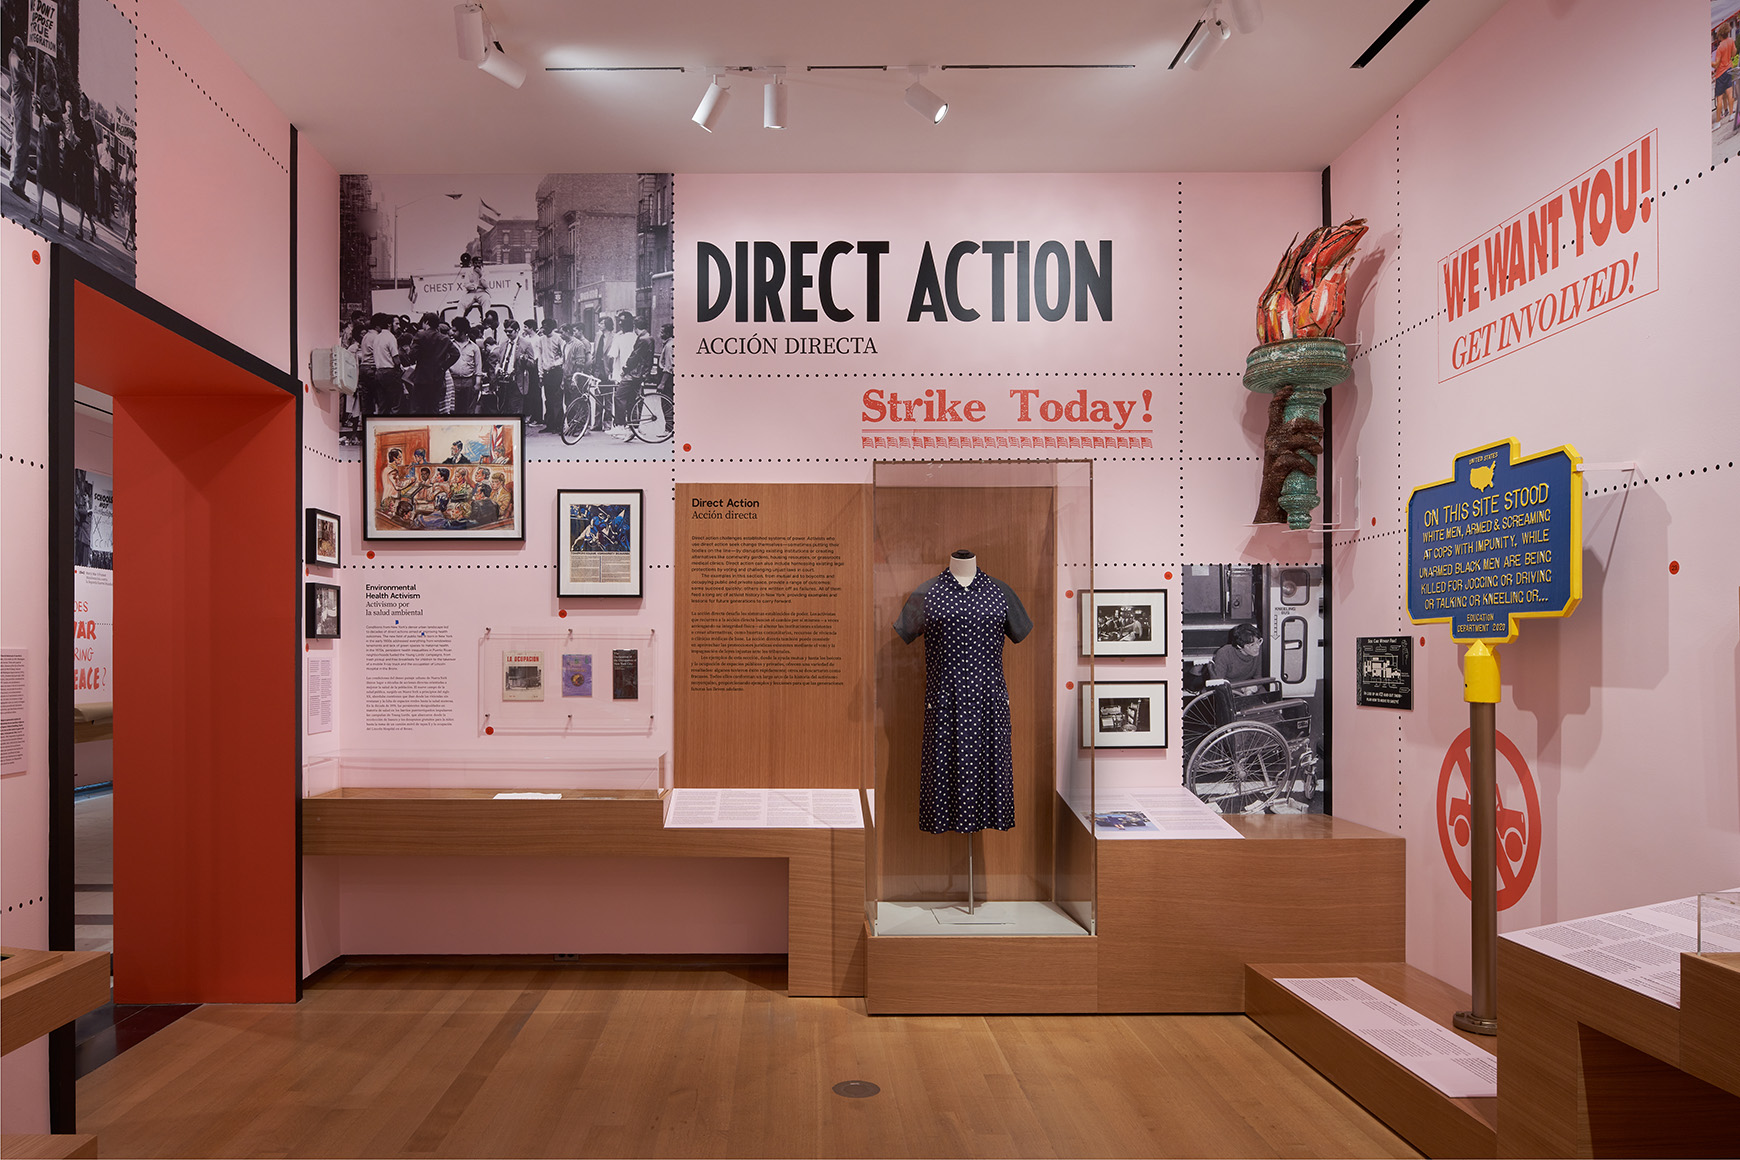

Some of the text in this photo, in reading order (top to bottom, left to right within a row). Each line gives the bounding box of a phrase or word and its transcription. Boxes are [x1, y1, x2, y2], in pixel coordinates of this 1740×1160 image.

[1444, 136, 1651, 322] WE WANT YOU!
[424, 284, 453, 293] CHEST
[489, 280, 511, 289] UNIT
[697, 240, 1112, 322] DIRECT ACTION
[1452, 252, 1640, 370] GET INVOLVED!
[696, 333, 878, 355] ACCIÓN DIRECTA
[862, 388, 1154, 430] Strike Today!
[1469, 452, 1498, 465] UNITED STATES
[692, 498, 760, 507] Direct Action
[692, 510, 758, 519] Acción directa
[1424, 482, 1549, 527] ON THIS SITE STOOD
[1423, 508, 1551, 543] WHITE MEN, ARMED & SCREAMING
[1423, 529, 1549, 560] AT COPS WITH IMPUNITY, WHILE
[1419, 550, 1552, 579] UNARMED BLACK MEN ARE BEING
[1421, 569, 1552, 595] KILLED FOR JOGGING OR DRIVING
[1425, 589, 1548, 610] OR TALKING OR KNEELING OR...
[1457, 623, 1506, 633] DEPARTMENT 2020
[1467, 613, 1494, 622] EDUCATION
[74, 647, 94, 661] RING
[74, 667, 107, 691] EACE?
